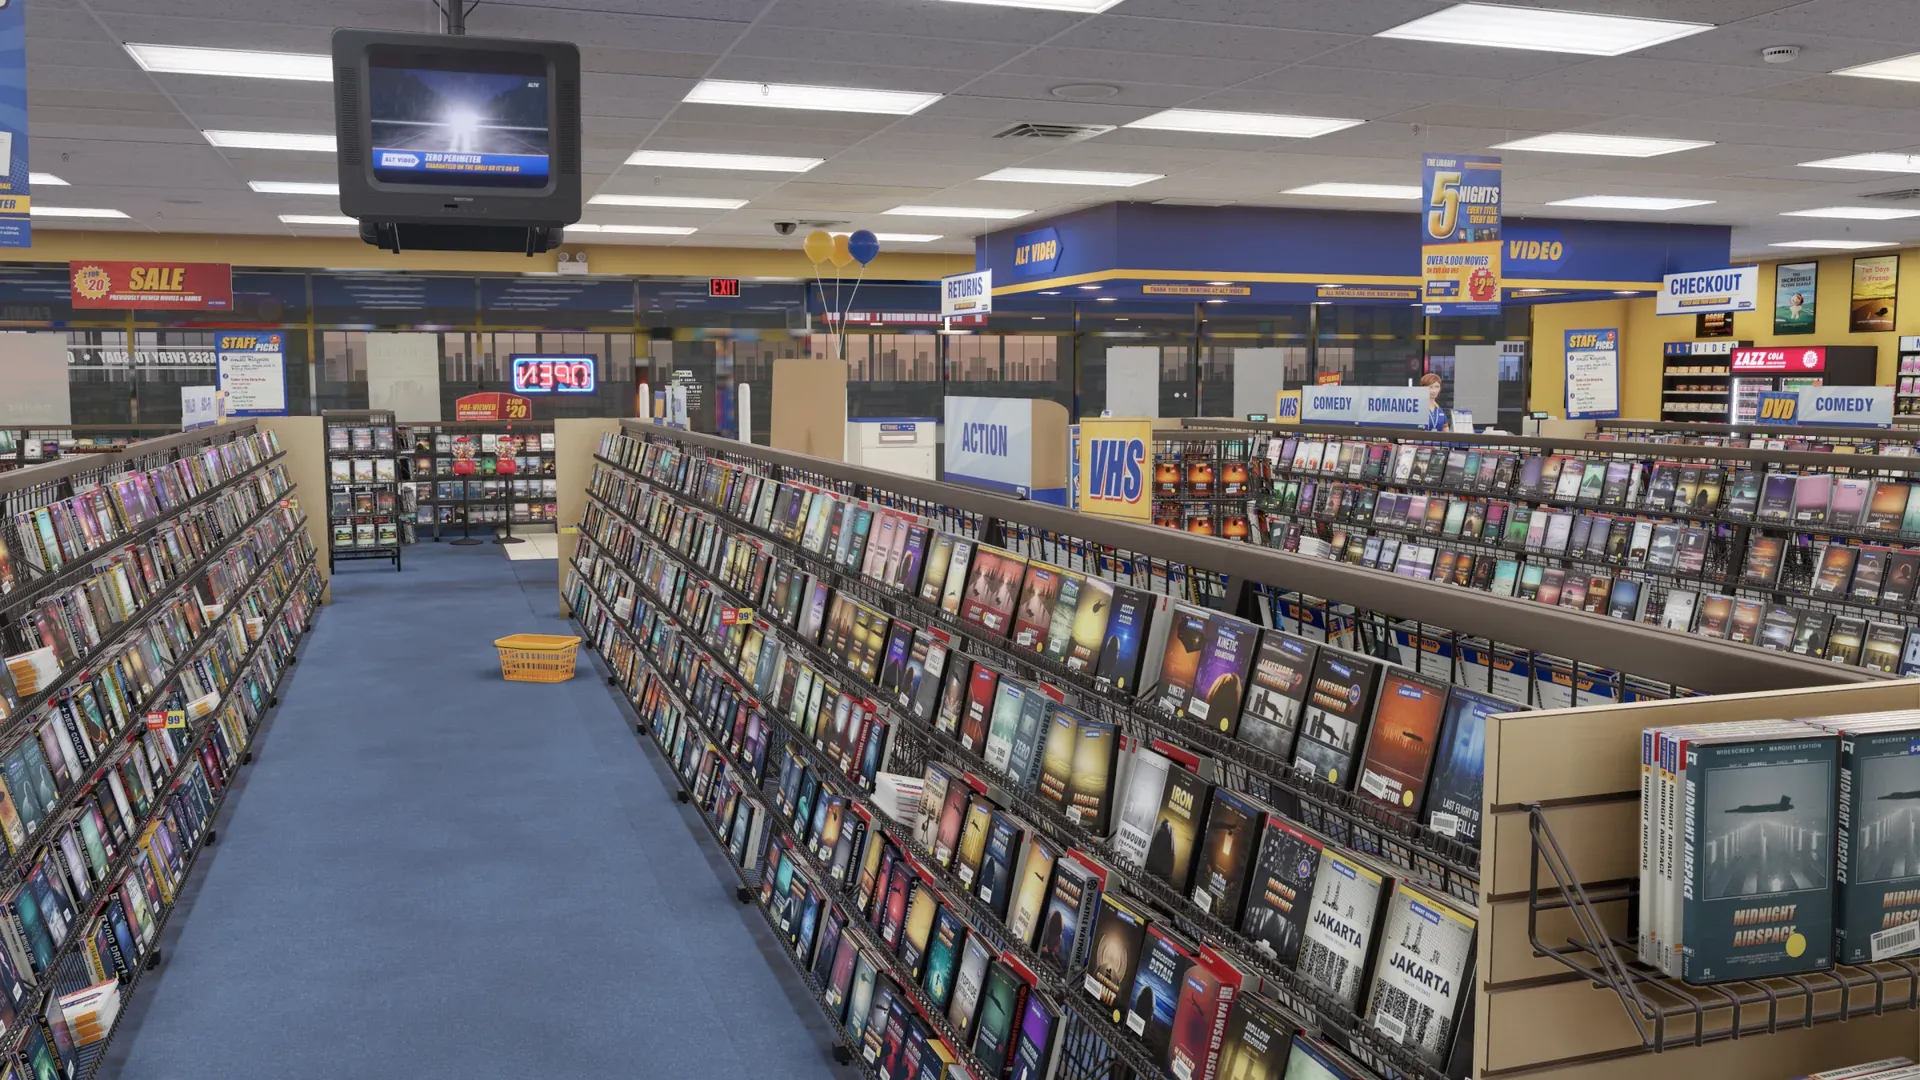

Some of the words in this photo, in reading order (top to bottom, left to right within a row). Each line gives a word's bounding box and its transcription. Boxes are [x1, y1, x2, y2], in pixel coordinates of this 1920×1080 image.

[384, 156, 396, 164] ALT
[424, 153, 442, 162] ZERO
[443, 154, 482, 164] PERIMETER
[1426, 158, 1436, 167] THE
[1436, 158, 1456, 168] LIBRARY
[1428, 171, 1462, 240] 5
[1458, 186, 1500, 204] NIGHTS
[1466, 206, 1482, 214] EVERY
[1470, 215, 1486, 224] EVERY
[1015, 246, 1030, 266] ALT
[1031, 240, 1056, 262] VIDEO
[1509, 240, 1563, 260] VIDEO
[1426, 256, 1444, 266] OVER
[1464, 256, 1488, 266] MOVIES
[84, 279, 105, 291] $20
[128, 266, 186, 291] SALE
[712, 279, 737, 295] EXIT
[948, 277, 983, 299] RETURNS
[1670, 274, 1742, 295] CHECKOUT
[222, 336, 256, 349] STAFF
[255, 344, 278, 352] PICKS
[1570, 334, 1598, 348] STAFF
[1595, 341, 1614, 350] PICKS
[1666, 345, 1690, 354] ALT
[1735, 352, 1766, 366] ZAZZ
[506, 406, 526, 418] $20
[1280, 398, 1298, 418] VHS
[1314, 396, 1352, 410] COMEDY
[1368, 398, 1418, 412] ROMANCE
[1760, 398, 1796, 420] DVD
[1816, 397, 1874, 412] COMEDY
[962, 422, 1007, 457] ACTION
[1089, 438, 1147, 503] VHS
[1216, 636, 1238, 652] KINETIC
[1260, 658, 1294, 676] LAKESHORE
[1168, 684, 1186, 699] KINETIC
[1257, 672, 1291, 692] STRONGHOLD
[1316, 678, 1350, 699] LAKESHORE
[1313, 692, 1347, 713] STRONGHOLD
[168, 715, 183, 725] 99¢
[1043, 711, 1054, 731] ZERO
[64, 713, 74, 731] DEEP
[71, 732, 87, 760] COLONY
[1872, 736, 1907, 745] WIDESCREEN
[1014, 739, 1030, 760] ZERO
[1031, 732, 1048, 780] BLOWBACK
[1043, 773, 1065, 792] ABSOLUTE
[1073, 792, 1099, 806] ABSOLUTE
[1171, 785, 1194, 808] IRON
[1839, 768, 1852, 829] MIDNIGHT
[1442, 798, 1454, 811] LAST
[1455, 800, 1472, 818] FLIGHT
[1472, 806, 1479, 822] TO
[1685, 779, 1696, 840] MIDNIGHT
[1120, 828, 1147, 849] INBOUND
[1837, 830, 1849, 884] AIRSPACE
[1683, 840, 1694, 901] AIRSPACE
[1058, 875, 1080, 899] VOLATILE
[1210, 872, 1227, 892] IRON
[1268, 876, 1296, 900] IRONCLAD
[1264, 890, 1293, 913] LONGSHOT
[1411, 903, 1426, 917] 5-NIGHT
[1425, 910, 1439, 923] RENTAL
[1733, 904, 1797, 926] MIDNIGHT
[12, 913, 24, 934] ZENITH
[20, 933, 32, 954] MINUS
[27, 951, 36, 965] ONE
[1313, 910, 1362, 949] JAKARTA
[1733, 926, 1796, 948] AIRSPACE
[103, 923, 116, 944] VOID
[110, 944, 126, 971] DRIFT
[1075, 926, 1087, 964] WAYPOINT
[1149, 962, 1173, 984] DETAIL
[1390, 952, 1450, 997] JAKARTA
[1212, 1002, 1228, 1051] HAWSER
